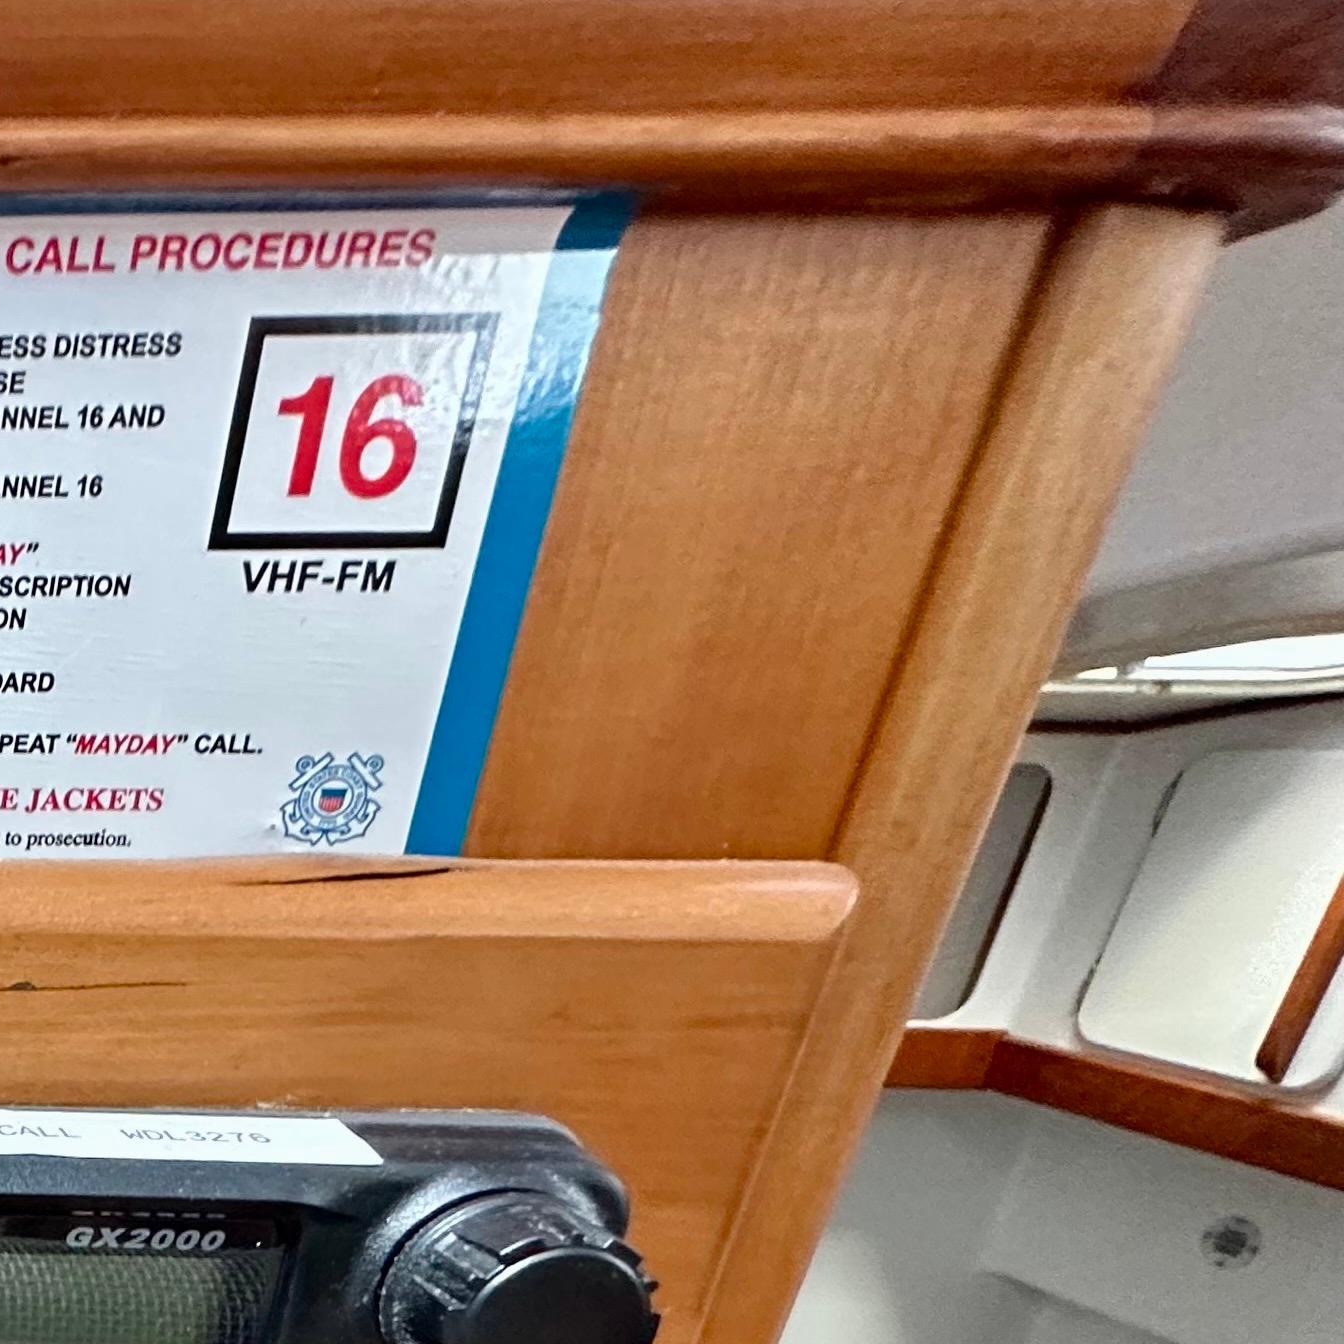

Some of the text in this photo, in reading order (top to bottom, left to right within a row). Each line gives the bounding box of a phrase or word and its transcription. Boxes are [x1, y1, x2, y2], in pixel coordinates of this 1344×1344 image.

[6, 236, 115, 274] CALL
[131, 230, 436, 271] PROCEDURES
[54, 333, 182, 358] DISTRESS
[278, 376, 422, 499] 16
[243, 561, 396, 592] VHF-FM
[195, 734, 262, 754] CALL.
[25, 788, 164, 813] JACKETS
[26, 829, 131, 850] prosecution.
[66, 1227, 225, 1251] GX2000
